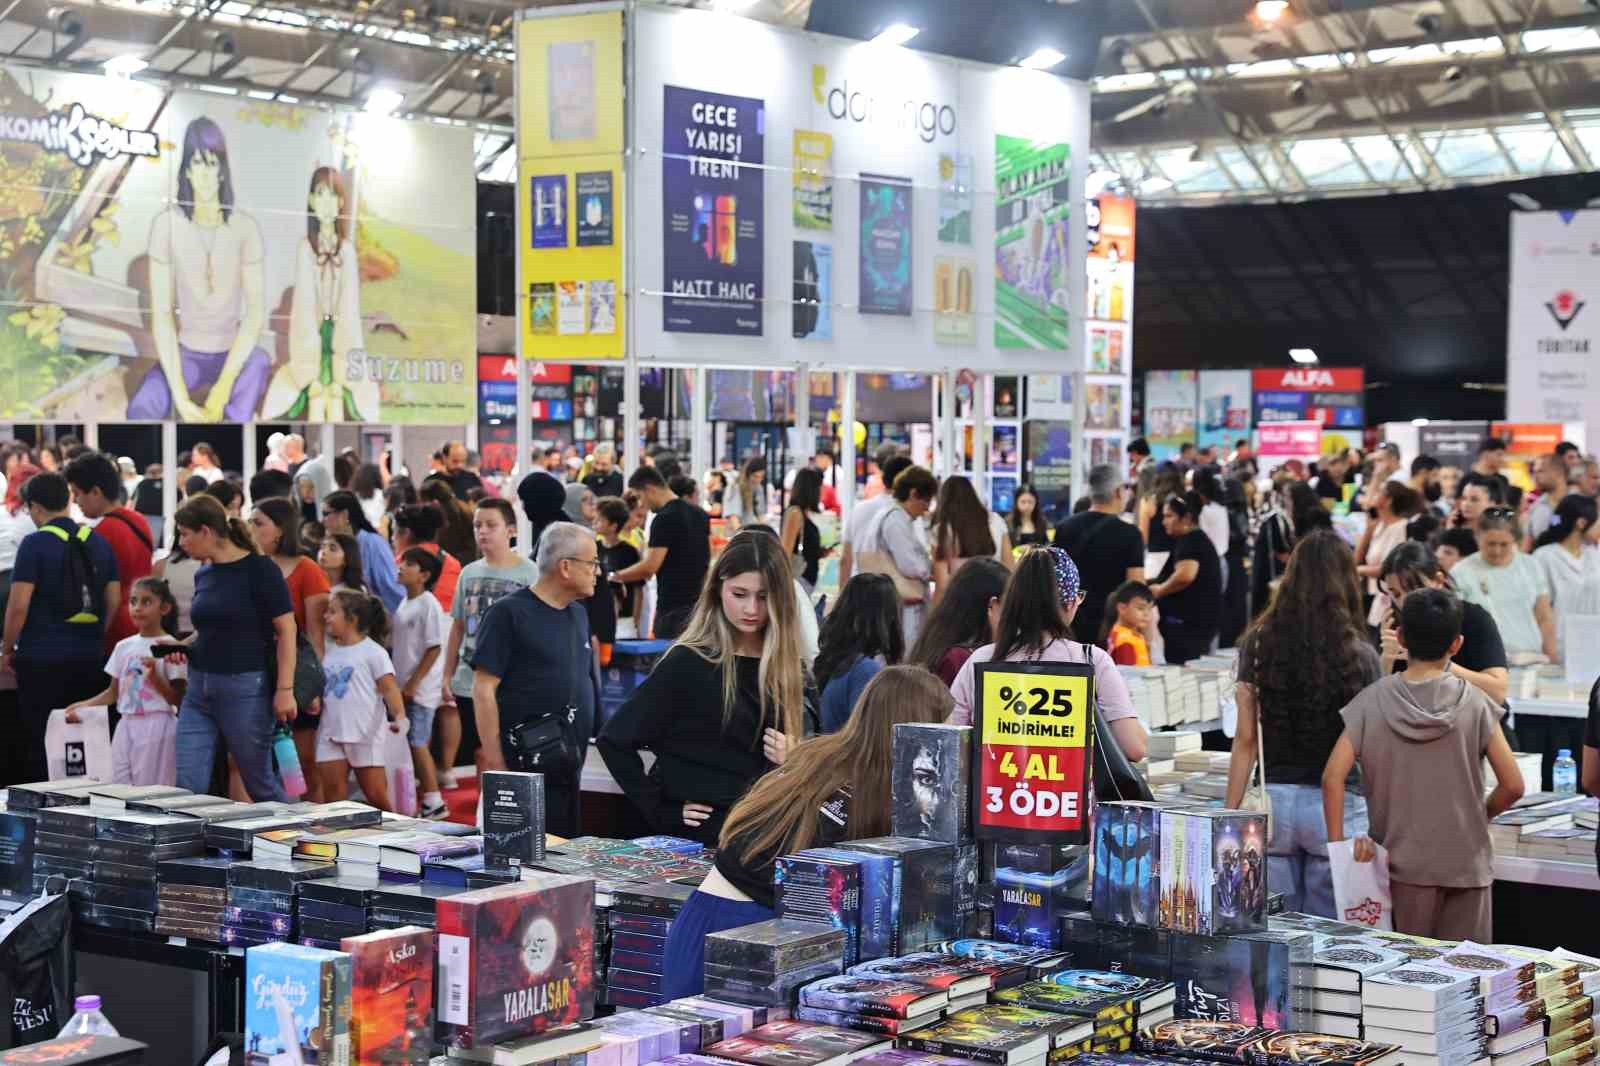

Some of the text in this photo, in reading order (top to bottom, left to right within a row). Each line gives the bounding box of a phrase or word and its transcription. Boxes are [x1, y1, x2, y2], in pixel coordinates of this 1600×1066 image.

[692, 102, 737, 128] GECE
[685, 128, 742, 154] YARISI
[688, 155, 740, 180] TRENİ
[672, 279, 755, 300] MATT HAIG
[345, 348, 464, 384] Suzume
[502, 358, 547, 377] AA
[1281, 369, 1335, 387] ALFA
[1000, 686, 1073, 717] %25
[997, 718, 1074, 738] İNDİRİMLE!
[999, 751, 1065, 781] 4 AL
[986, 786, 1004, 813] 3
[1009, 781, 1079, 818] ÖDE
[1002, 889, 1042, 908] YARALASAR
[503, 977, 570, 1023] YARALASAR
